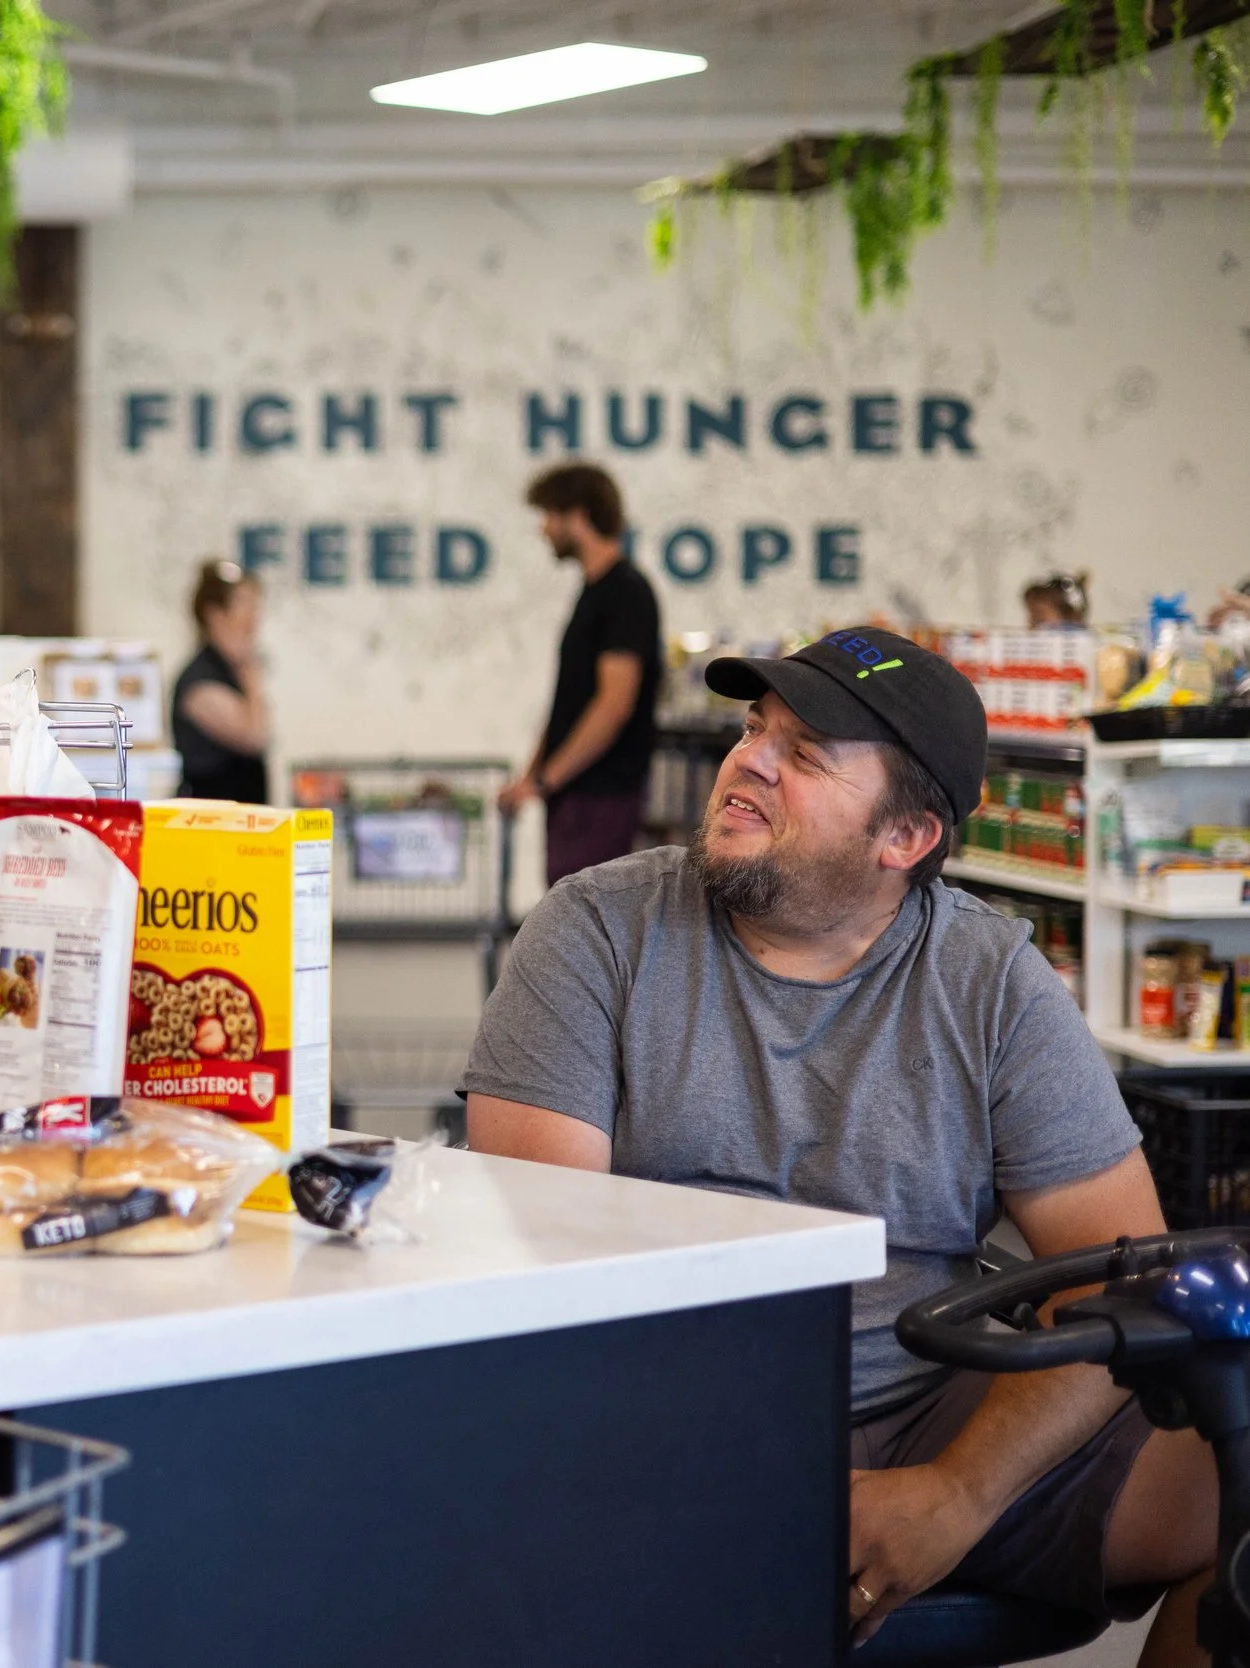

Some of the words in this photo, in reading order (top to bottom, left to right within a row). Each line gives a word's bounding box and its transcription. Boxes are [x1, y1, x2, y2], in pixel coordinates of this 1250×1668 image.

[124, 392, 458, 454] FIGHT
[526, 392, 978, 455] HUNGER
[240, 526, 491, 586] FEED
[622, 526, 861, 586] OPE
[818, 631, 904, 679] EED!
[139, 877, 258, 934] eerios
[200, 941, 240, 957] OATS
[124, 1080, 141, 1097] ER
[148, 1066, 171, 1079] CAN
[173, 1063, 203, 1077] HELP
[34, 1214, 86, 1247] KETO
